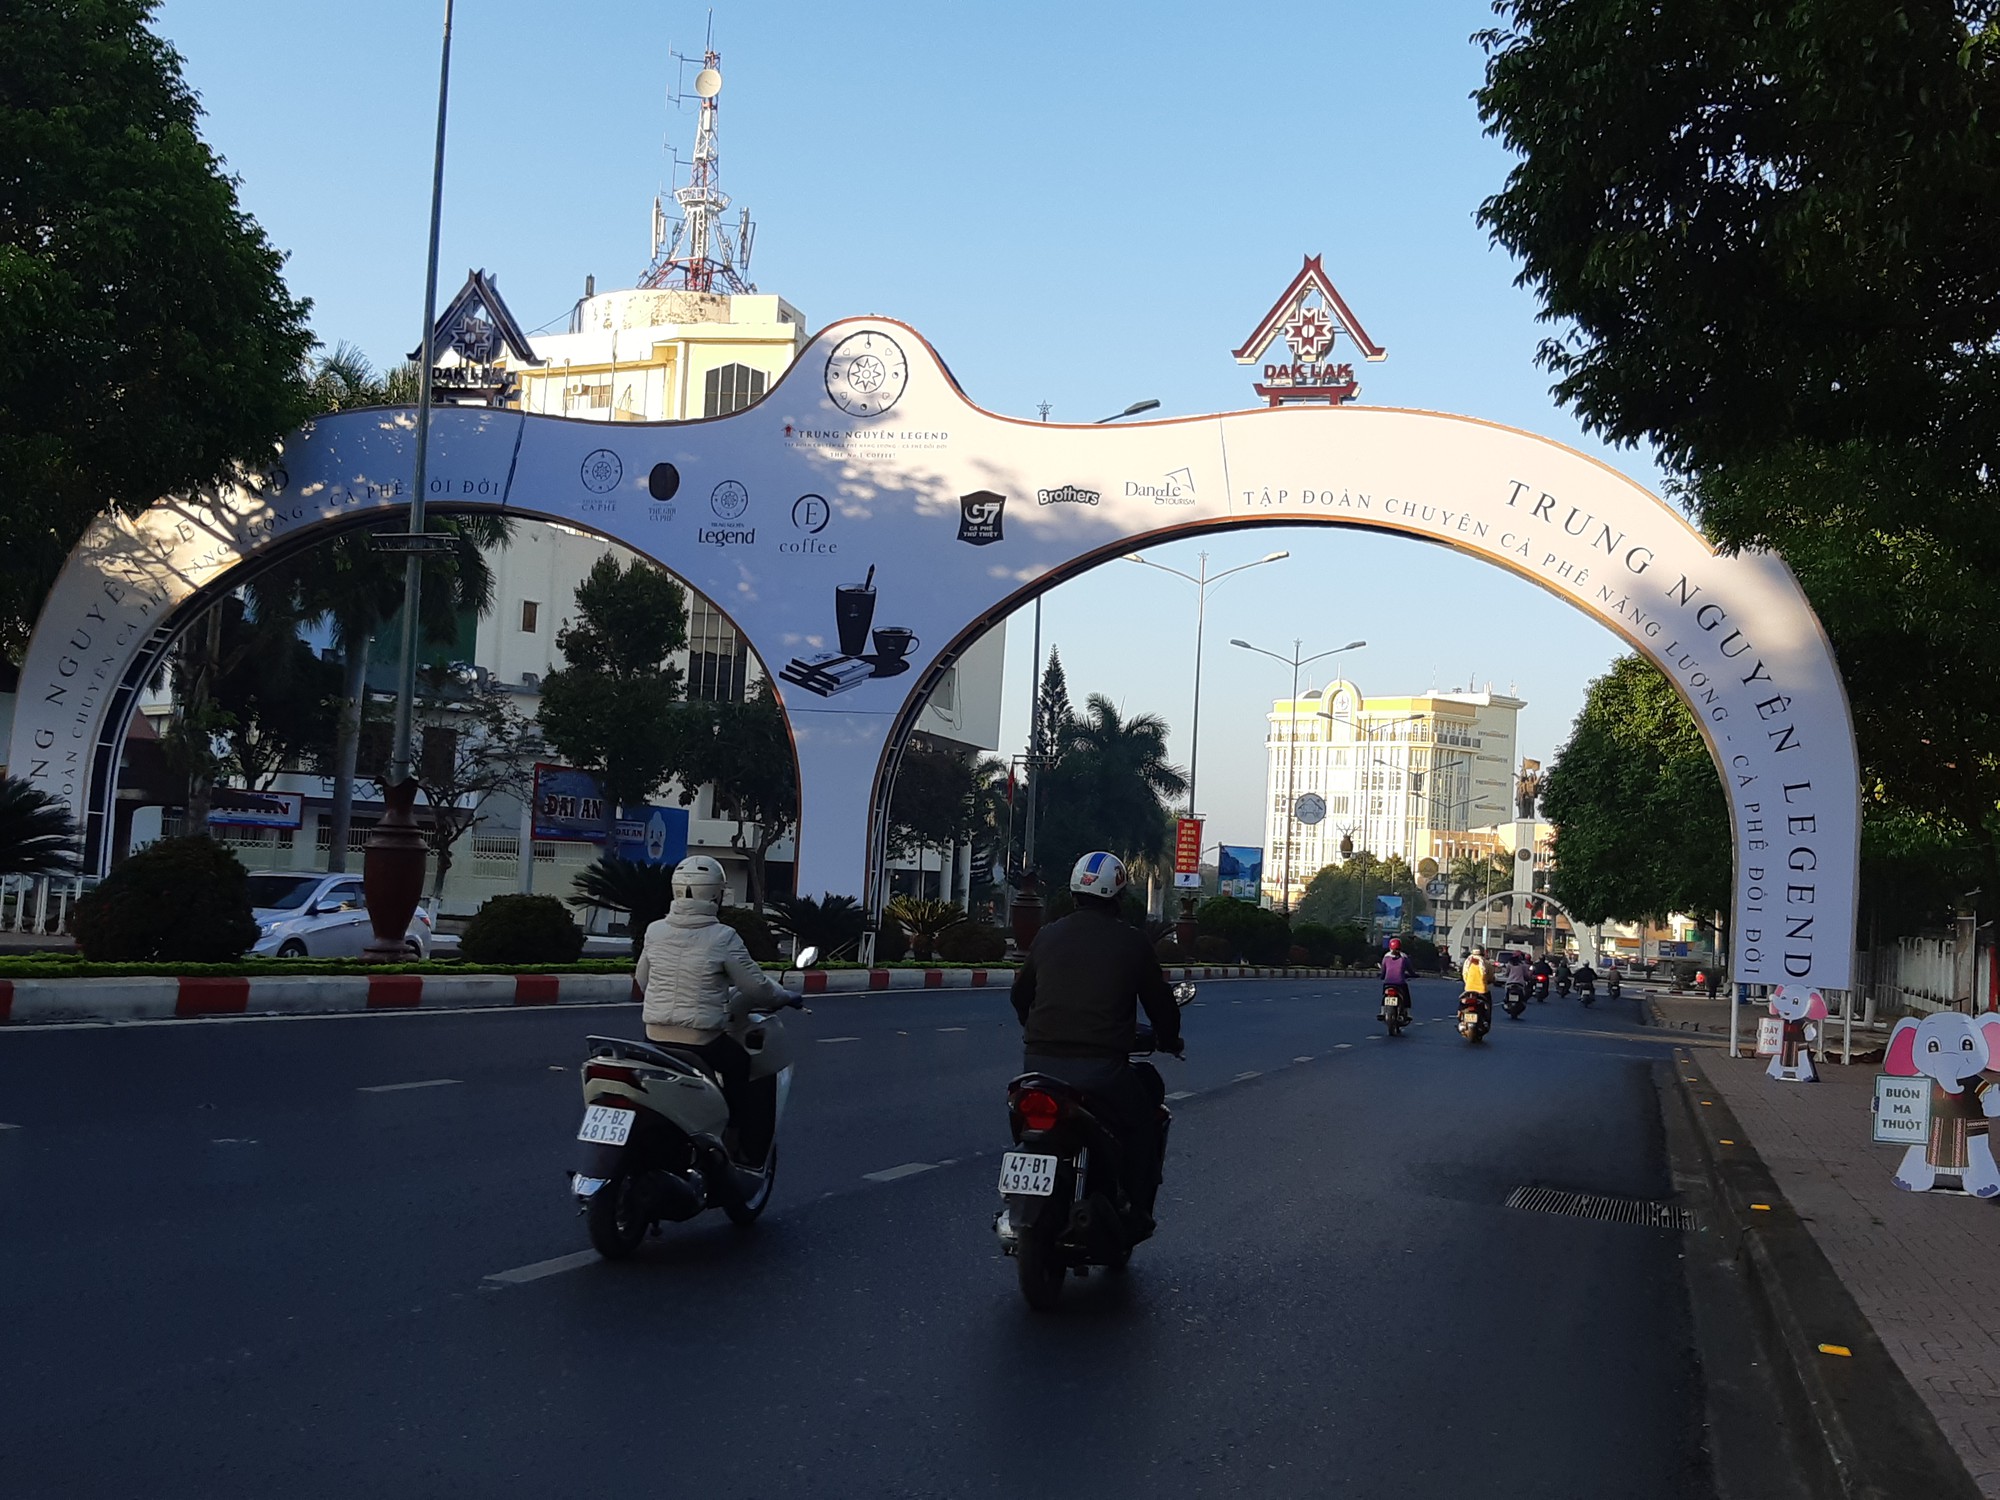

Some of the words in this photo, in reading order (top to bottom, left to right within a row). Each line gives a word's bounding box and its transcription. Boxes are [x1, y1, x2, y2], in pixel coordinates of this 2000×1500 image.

[799, 430, 840, 440] TRUNG
[845, 428, 895, 440] NGUYÊN
[900, 431, 949, 441] LEGEND
[1038, 485, 1100, 506] Brothers
[1165, 498, 1196, 506] TOURISM
[1242, 486, 1289, 508] TẬP
[1302, 488, 1371, 510] ĐOÀN
[964, 501, 1000, 525] G7
[1384, 498, 1490, 539] CHUYÊN
[698, 527, 756, 548] Legend
[779, 537, 838, 554] coffee
[1500, 532, 1531, 558] CÀ
[1541, 552, 1590, 588] PHÊ
[72, 654, 116, 739] CHUYÊN
[139, 578, 174, 617] PHÊ
[329, 487, 356, 507] CÀ
[366, 478, 404, 499] PHÊ
[462, 477, 499, 496] ĐỜI
[1595, 584, 1663, 638] NĂNG
[45, 559, 146, 707] NGUYÊN
[1664, 640, 1729, 722] LƯỢNG
[1504, 479, 1655, 576] TRUNG
[1665, 573, 1802, 753] NGUYÊN
[1781, 778, 1818, 978] LEGEND
[1732, 754, 1759, 788] CÀ
[580, 797, 604, 820] AN
[1744, 802, 1770, 851] PHÊ
[1747, 867, 1769, 912] ĐỔI
[1743, 928, 1765, 973] ĐỜI
[1886, 1087, 1920, 1099] BUÔN
[592, 1107, 628, 1126] 47-B2
[1893, 1104, 1912, 1114] MA
[581, 1123, 628, 1142] 481.58
[1882, 1119, 1922, 1132] THUỘT
[1010, 1156, 1048, 1174] 47-B1
[1002, 1173, 1052, 1193] 493.42
